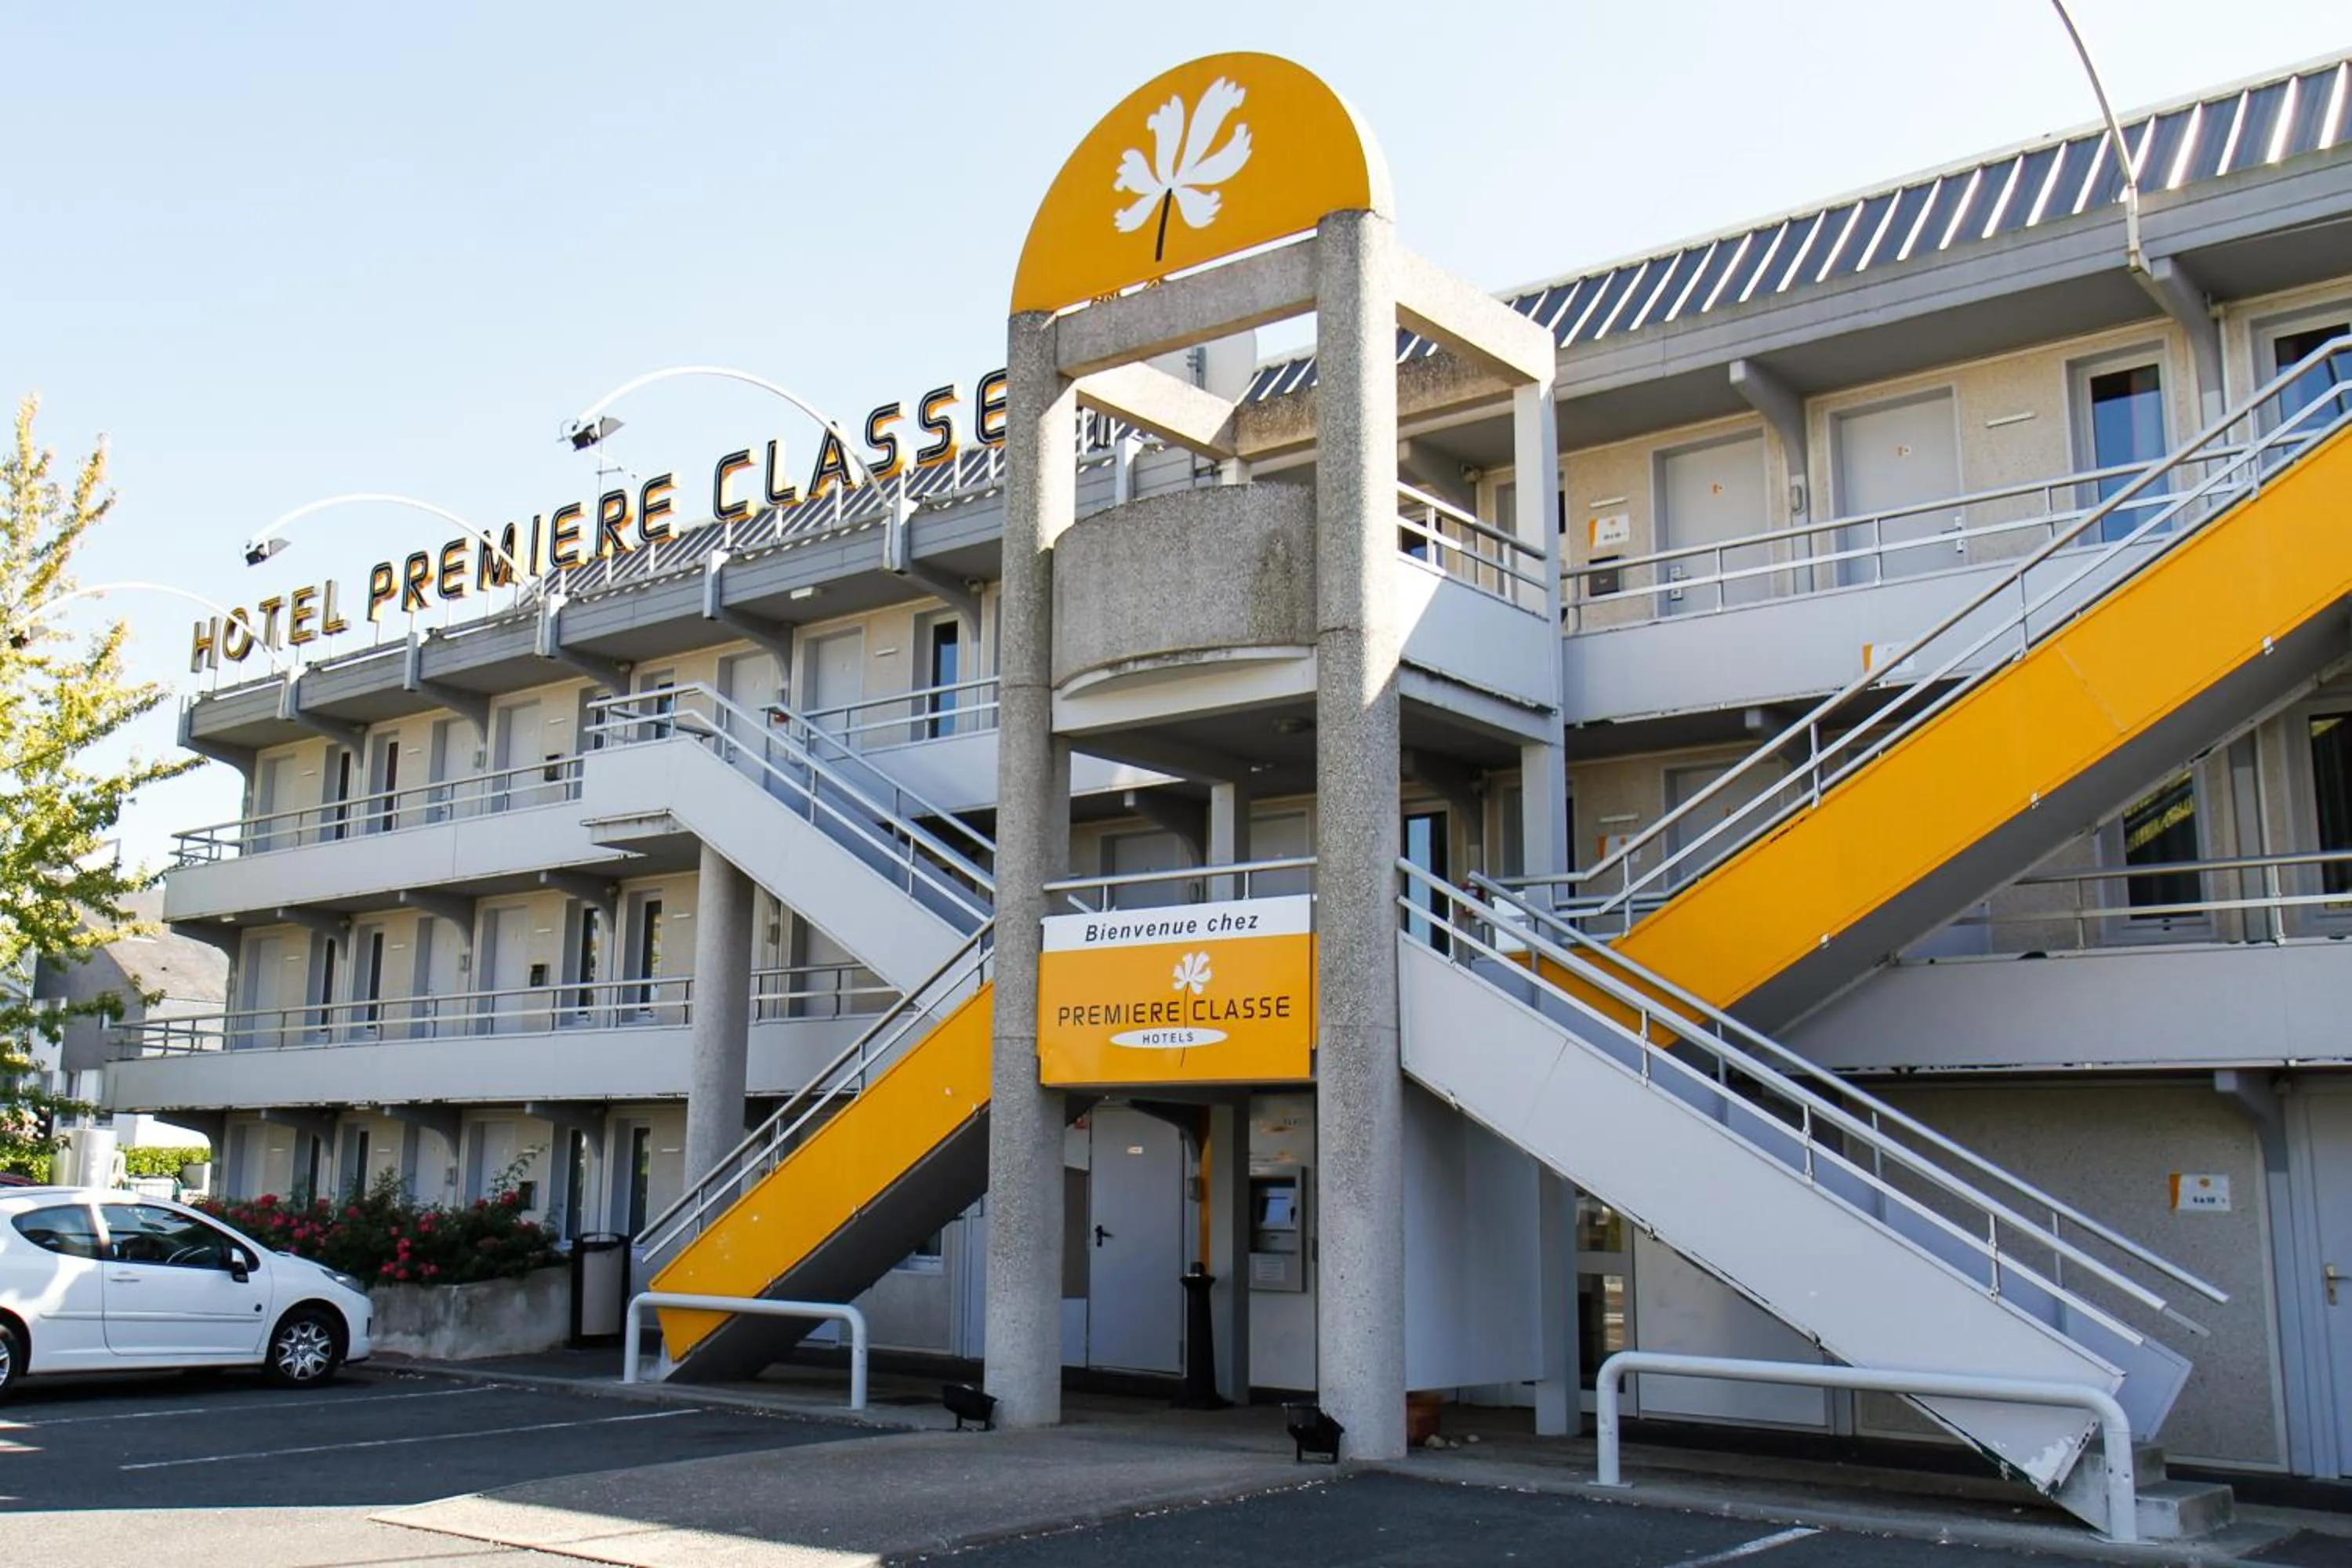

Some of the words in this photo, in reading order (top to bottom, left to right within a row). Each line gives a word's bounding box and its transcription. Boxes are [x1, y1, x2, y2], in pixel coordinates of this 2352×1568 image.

[190, 579, 351, 673] HOTEL
[366, 472, 681, 622] PREMIERE
[713, 367, 1008, 522] CLASSE
[1085, 918, 1197, 942] Bienvenue
[1207, 913, 1259, 932] chez
[1058, 1000, 1181, 1027] PREMIERE
[1192, 996, 1291, 1021] CLASSE
[1142, 1031, 1195, 1046] HOTELS
